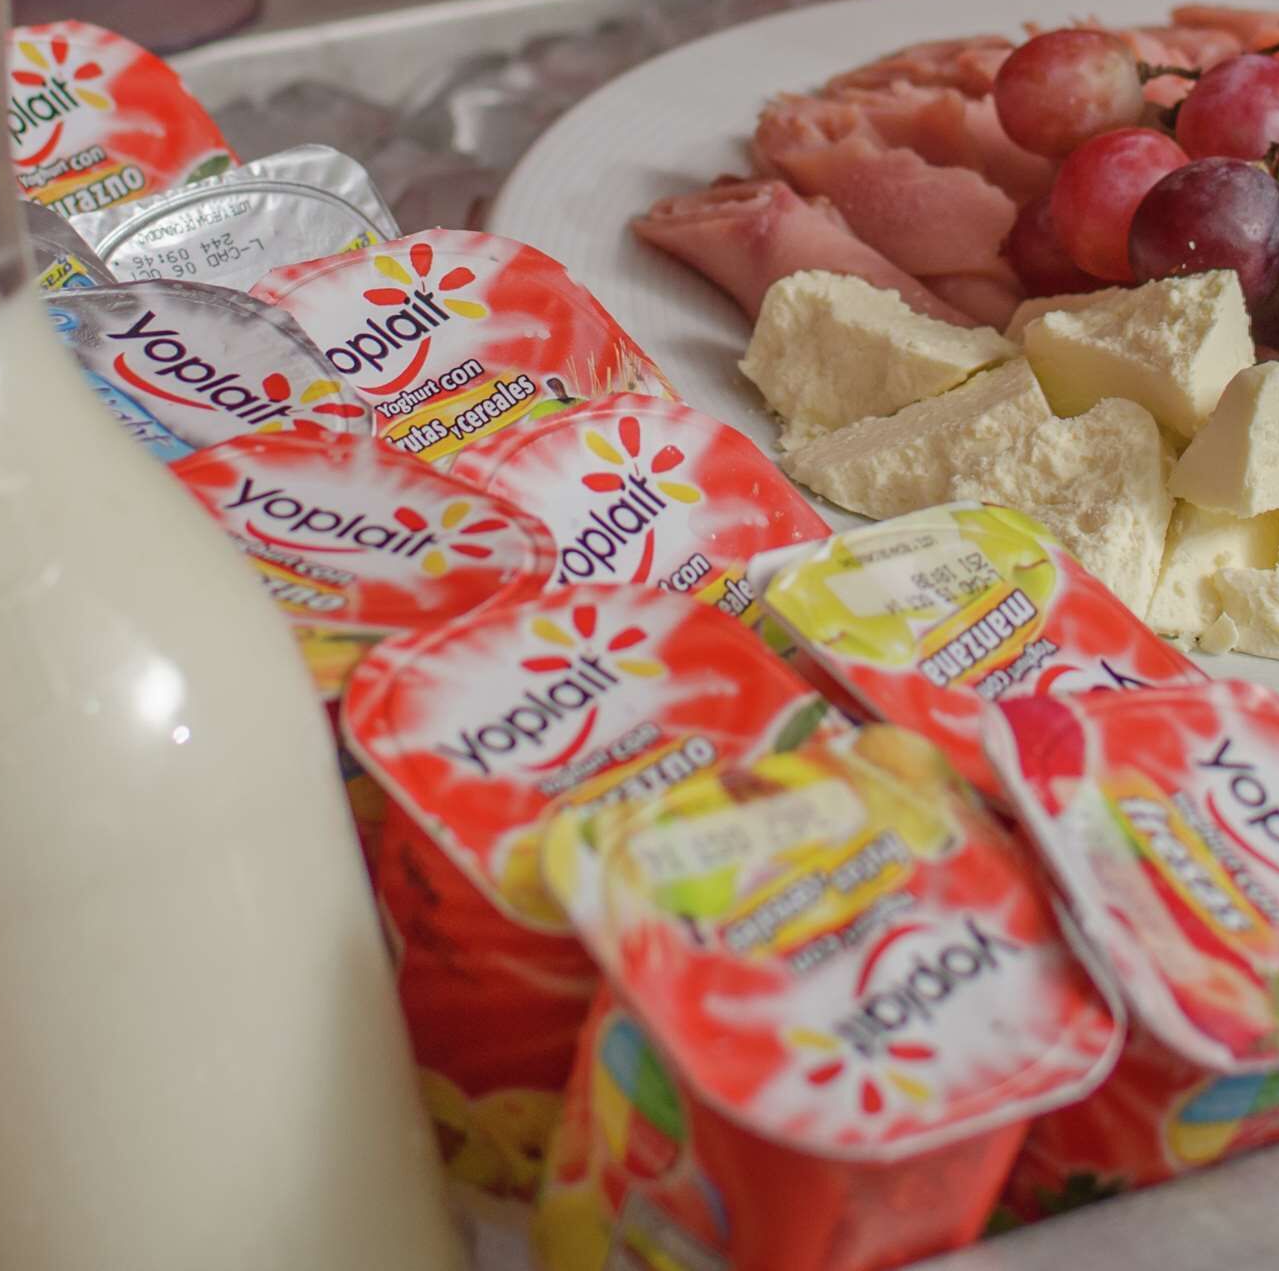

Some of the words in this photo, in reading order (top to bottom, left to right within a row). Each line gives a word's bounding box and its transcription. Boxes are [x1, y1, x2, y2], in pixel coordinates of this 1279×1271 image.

[7, 76, 80, 146] plait
[69, 144, 108, 172] con
[44, 164, 146, 218] urazno
[132, 247, 191, 270] 09:46
[171, 261, 197, 278] 06
[200, 232, 235, 254] 244
[206, 238, 265, 268] L-CAD
[323, 286, 452, 377] oplait
[375, 379, 441, 418] Yoghurt
[439, 358, 485, 391] con
[455, 374, 537, 434] cereales
[557, 473, 668, 585] oplait
[669, 551, 713, 593] con
[918, 587, 1039, 688] manzana
